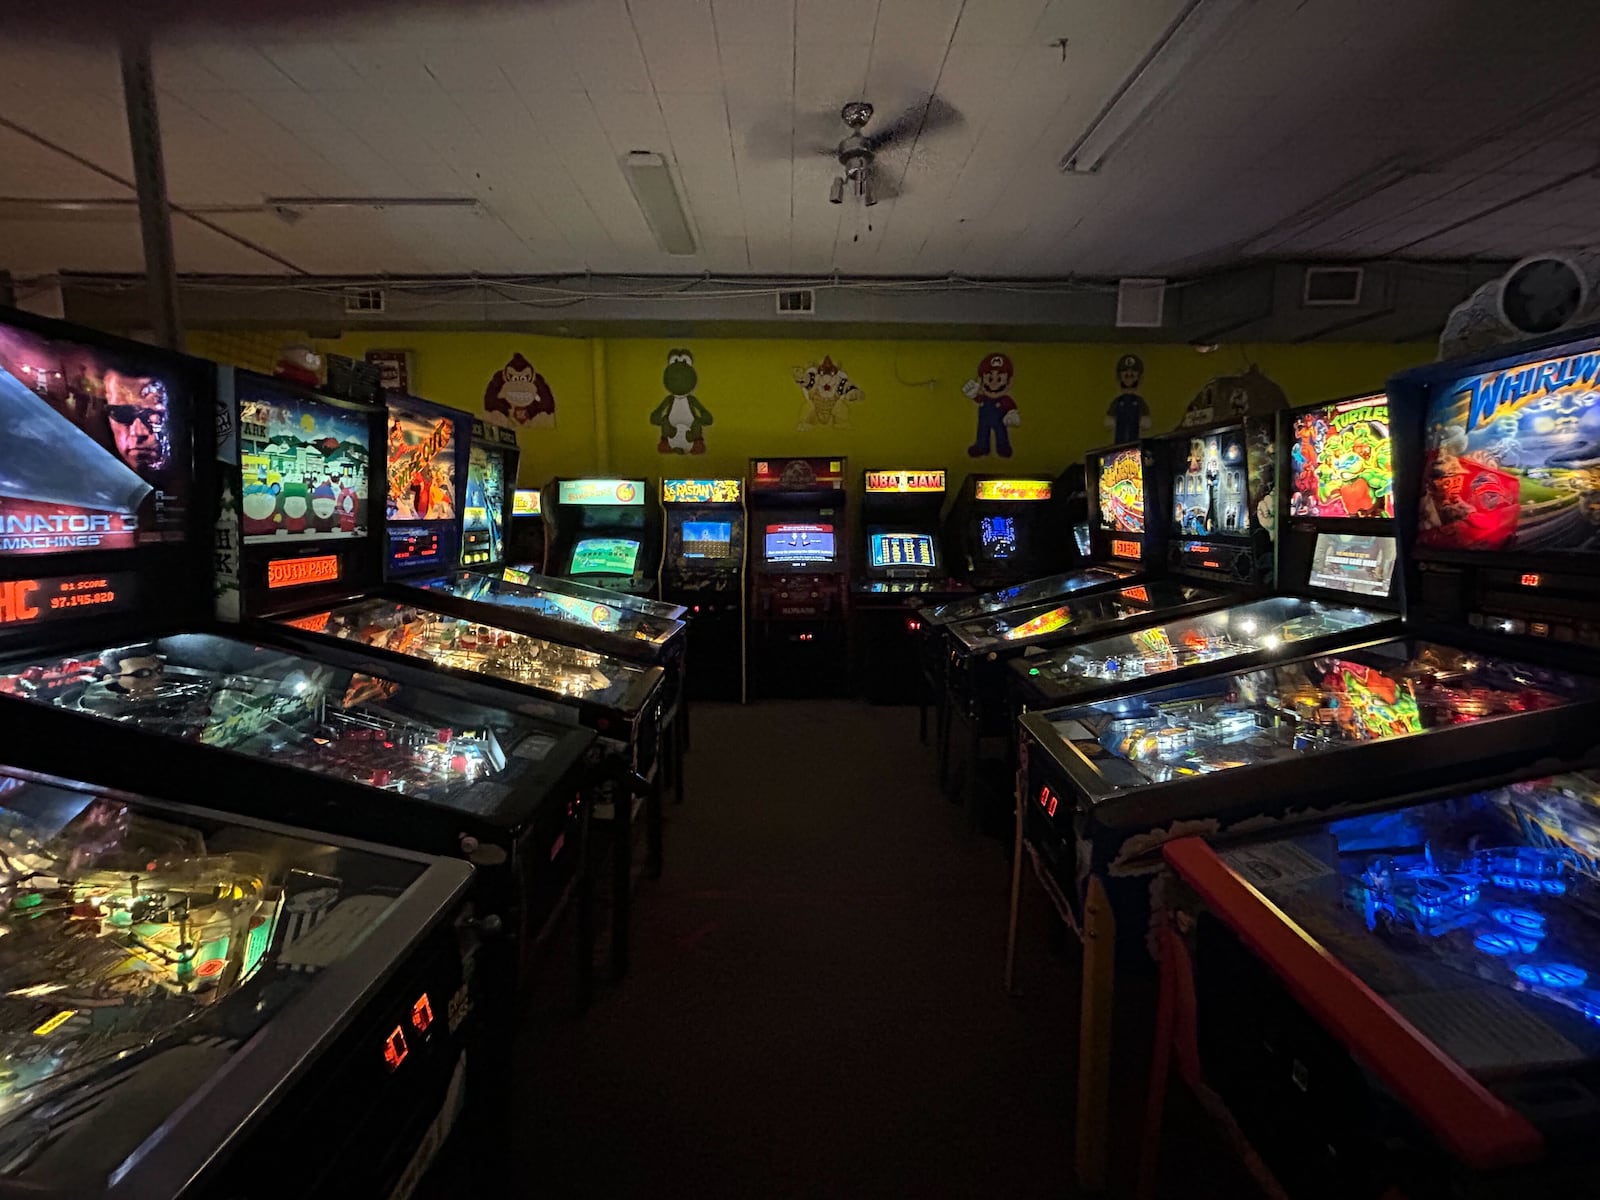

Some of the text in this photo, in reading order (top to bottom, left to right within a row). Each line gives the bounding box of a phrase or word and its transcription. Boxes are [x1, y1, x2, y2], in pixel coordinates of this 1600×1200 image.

[870, 473, 941, 488] NBA JAM
[676, 483, 711, 496] RASTAN
[3, 535, 100, 549] MACHINES
[268, 559, 337, 580] SOUTH PARK
[77, 580, 107, 590] SCORE
